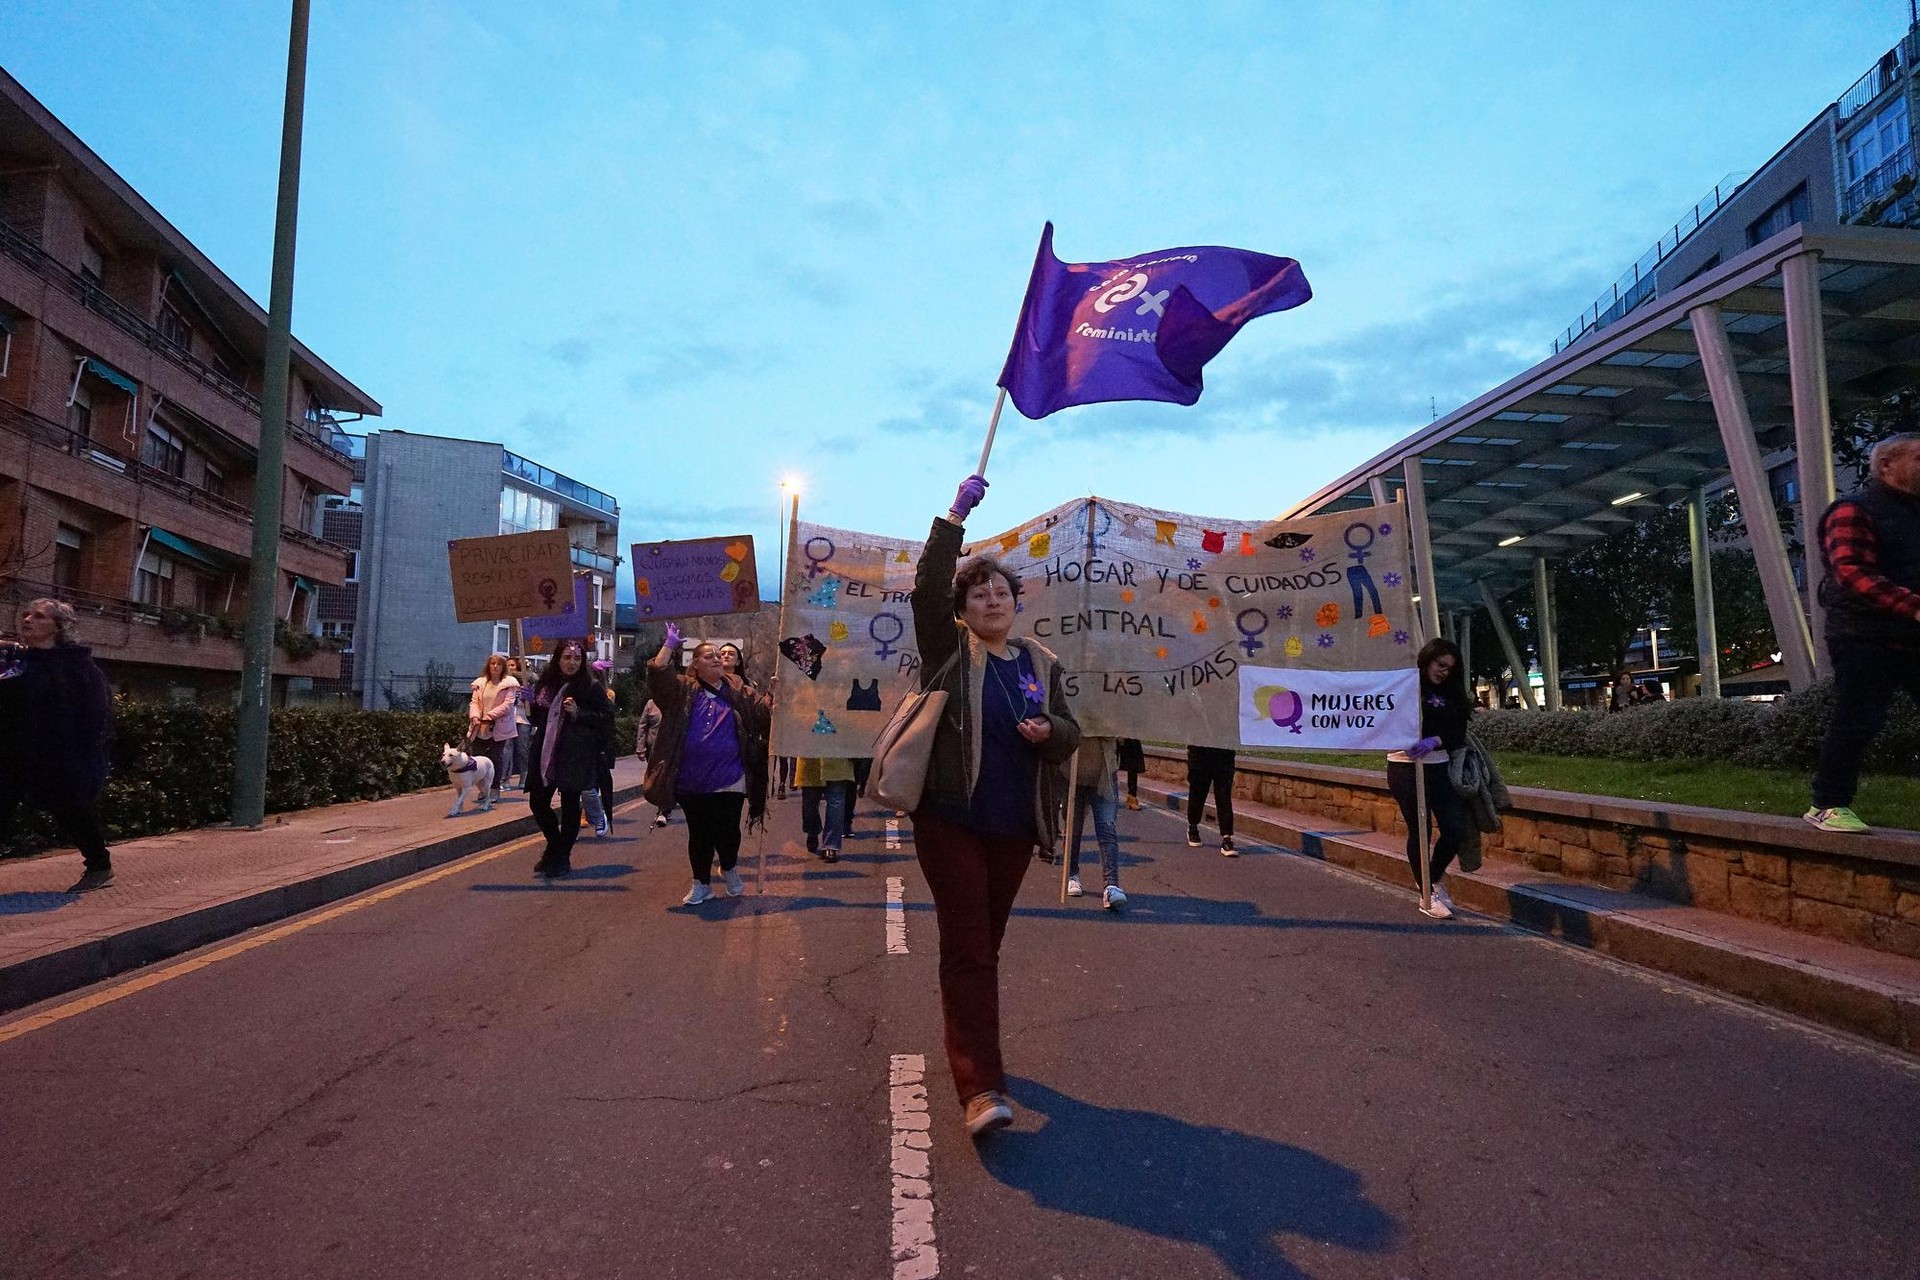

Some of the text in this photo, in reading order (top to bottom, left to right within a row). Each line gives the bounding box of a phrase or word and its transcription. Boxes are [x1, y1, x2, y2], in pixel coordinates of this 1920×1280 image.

[460, 542, 561, 566] PRIVACIDAD
[846, 581, 873, 599] EL
[1045, 557, 1137, 587] HOGAR
[1178, 572, 1209, 591] DE
[1225, 562, 1342, 594] CUIDADOS
[1034, 608, 1177, 638] CENTRAL
[1103, 672, 1143, 697] LAS
[1164, 650, 1239, 697] VIDAS
[1312, 693, 1395, 711] MUJERES
[1312, 714, 1375, 729] CON VOZ
